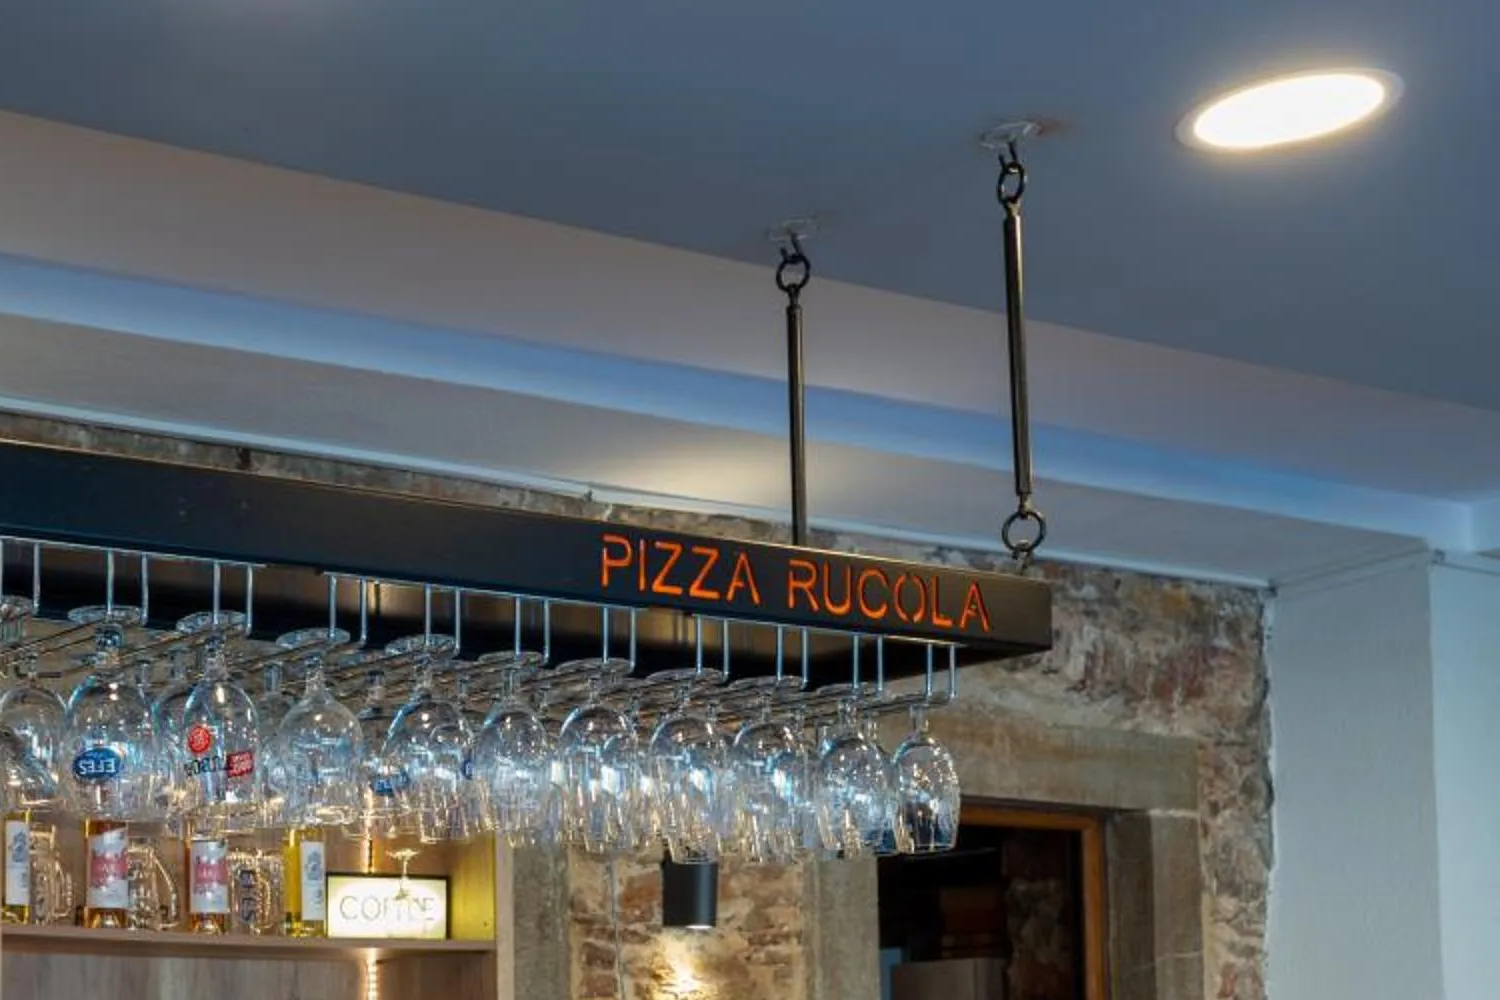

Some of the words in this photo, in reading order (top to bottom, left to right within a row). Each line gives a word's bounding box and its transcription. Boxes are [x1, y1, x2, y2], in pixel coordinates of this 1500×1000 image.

[600, 532, 762, 605] PIZZA
[785, 558, 991, 633] RUCOLA
[79, 758, 117, 775] EFES
